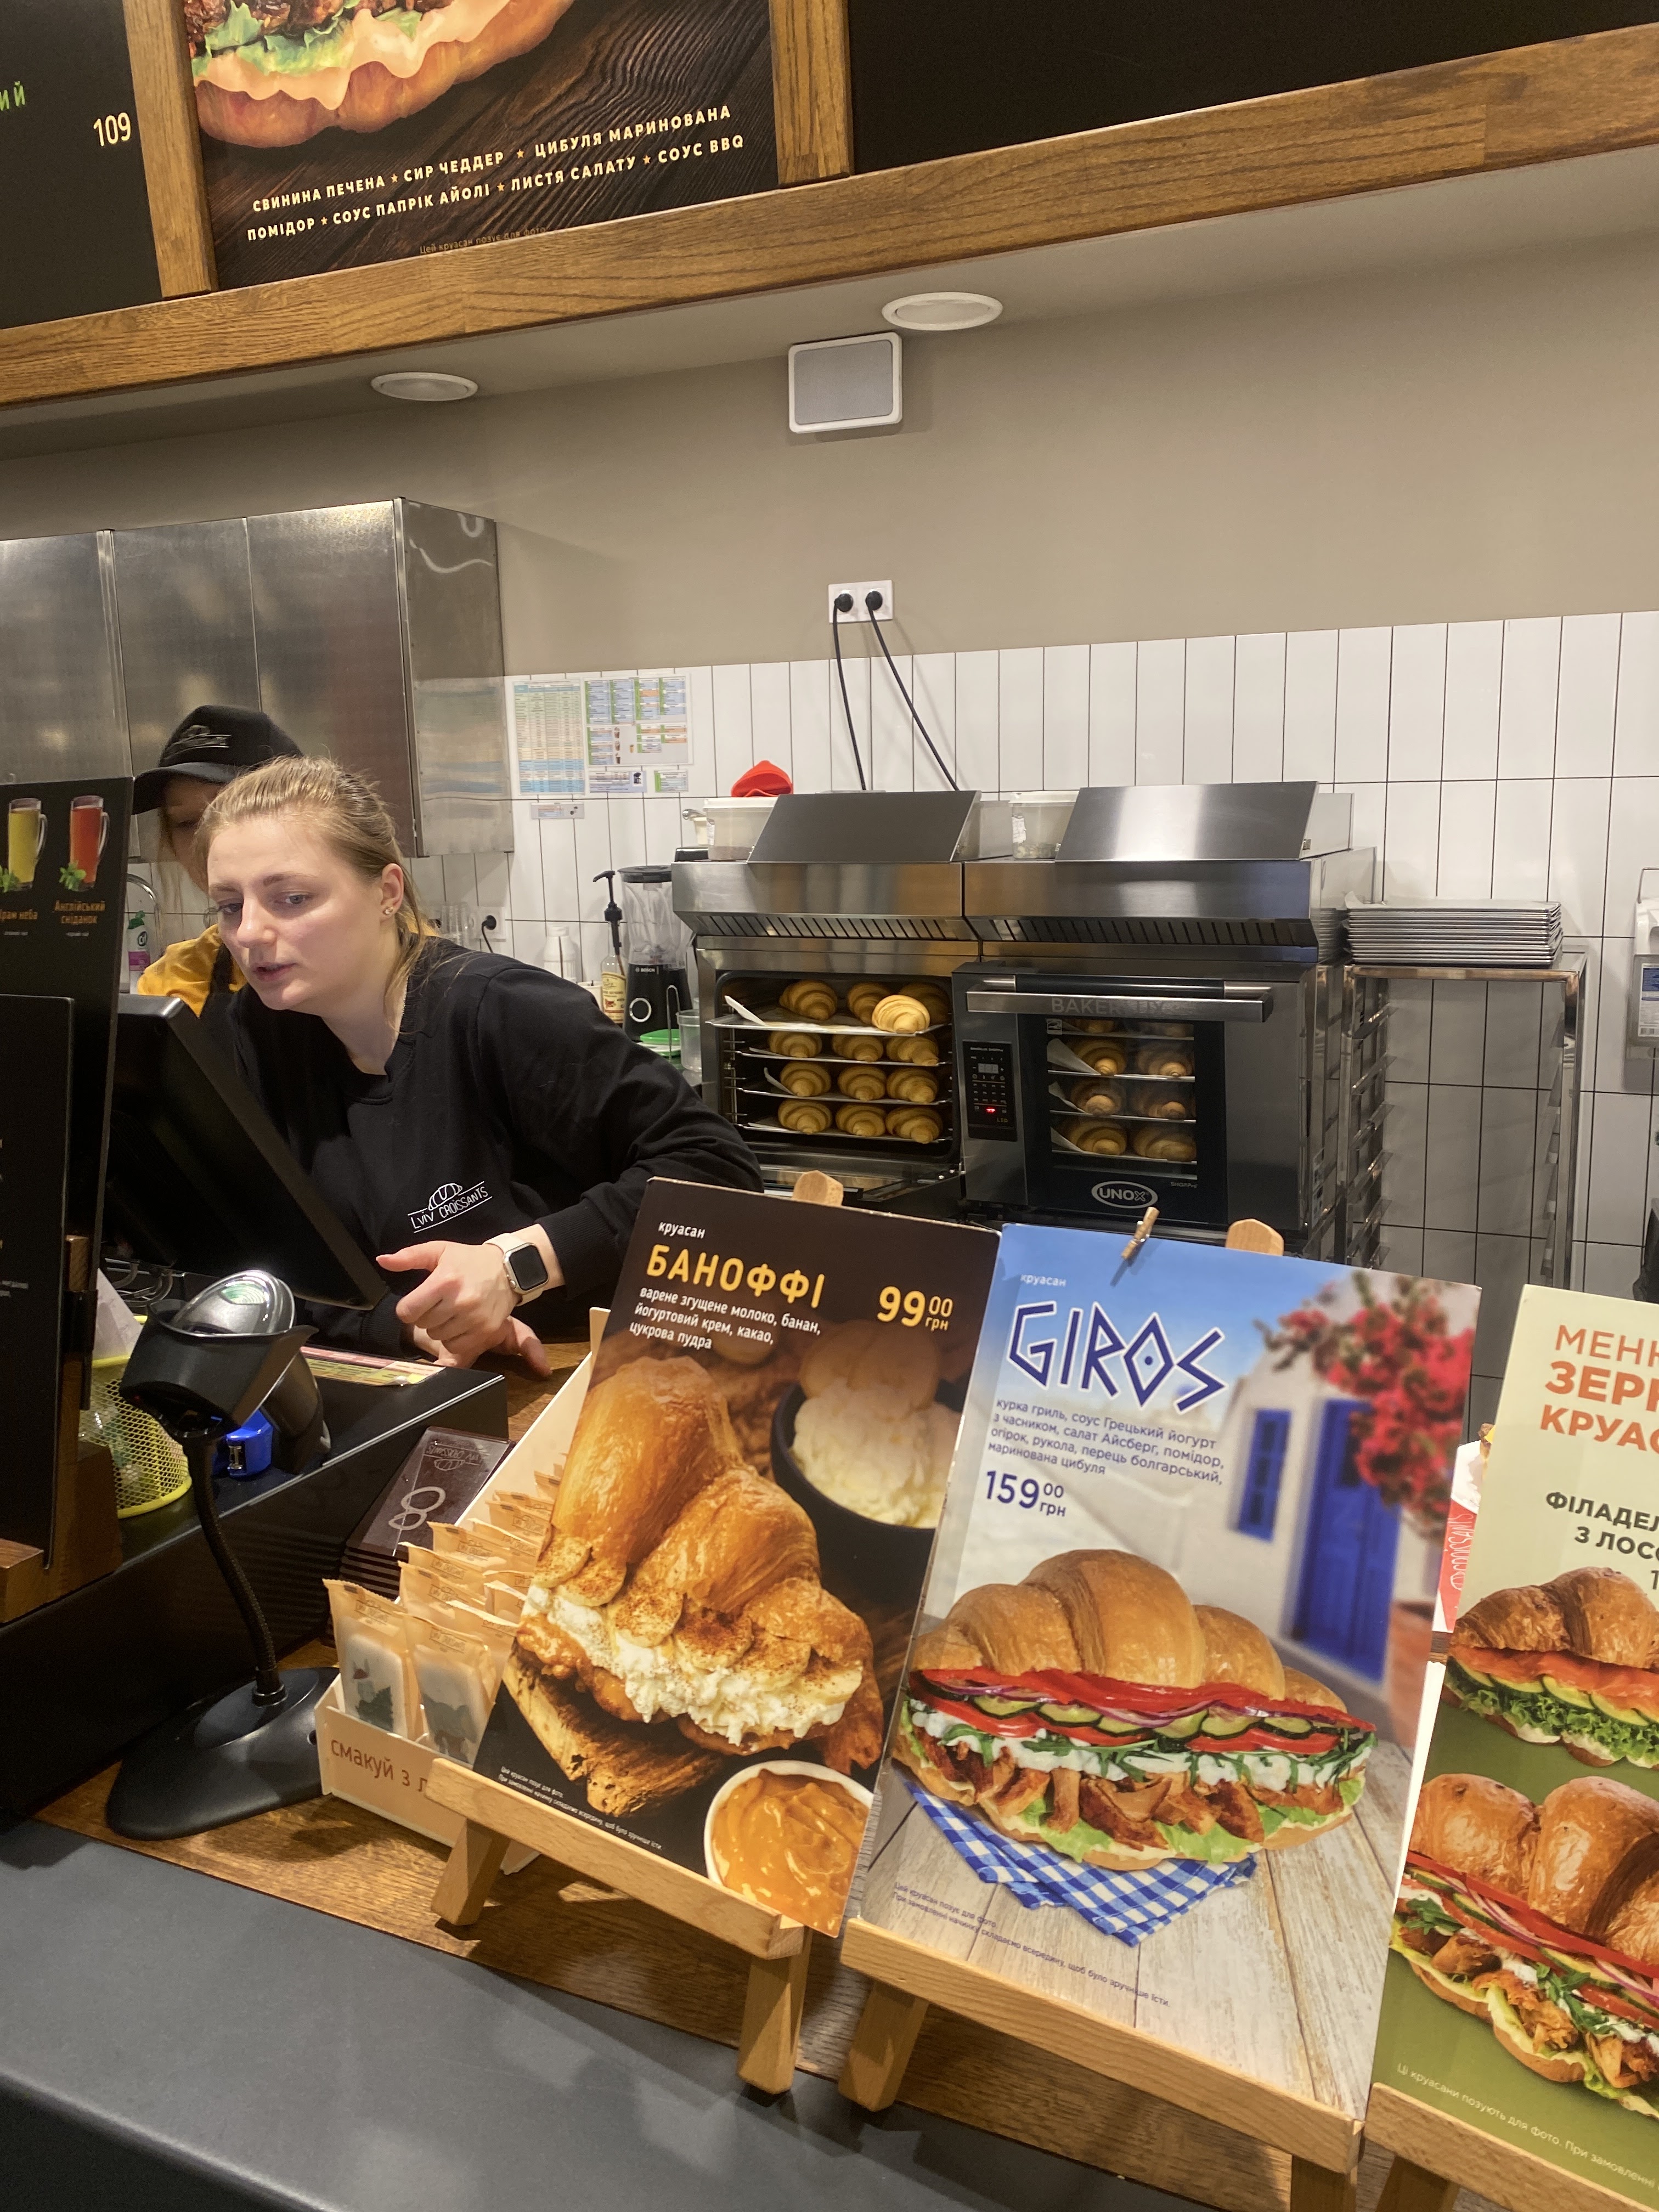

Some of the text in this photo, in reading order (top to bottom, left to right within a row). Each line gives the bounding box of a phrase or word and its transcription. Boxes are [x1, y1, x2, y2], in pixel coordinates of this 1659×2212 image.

[93, 112, 131, 146] 109
[252, 105, 731, 212] СВИНИНА ПЕЧЕНА СИР ЧЕДДЕР ЦИБУЛЯ МАРИНОВАНА
[247, 135, 743, 241] ПОМІДОР СОУС ПАПРІК АЙОЛІ ЛИСТЯ САЛАТУ СОУС BBQ
[1099, 1187, 1146, 1202] UNOX
[658, 1221, 706, 1239] круасан
[646, 1244, 825, 1308] БАНОФФІ
[1020, 1273, 1066, 1288] круасан
[634, 1302, 774, 1345] йогуртовий крем, какао,
[640, 1288, 821, 1335] варене згущене молоко, банан,
[924, 1317, 949, 1331] грн
[629, 1322, 713, 1350] цукрова пудра
[1007, 1301, 1228, 1414] GIROS
[994, 1413, 1224, 1469] з часником, салат Айсберг, помідор,
[996, 1400, 1217, 1449] курка гриль, соус Грецький йогурт
[988, 1442, 1105, 1474] маринована цибуля
[1032, 1436, 1077, 1454] рукола,
[1082, 1446, 1127, 1464] перець
[1131, 1455, 1222, 1485] болгарський,
[1039, 1502, 1066, 1517] грн
[1595, 1531, 1659, 1561] ЛОС
[331, 1740, 393, 1781] смакуй
[402, 1769, 410, 1787] з
[894, 1881, 908, 1892] Цей
[1088, 1970, 1108, 1983] було
[1397, 2063, 1656, 2188] Ці круасани позують для фото. При замовленні
